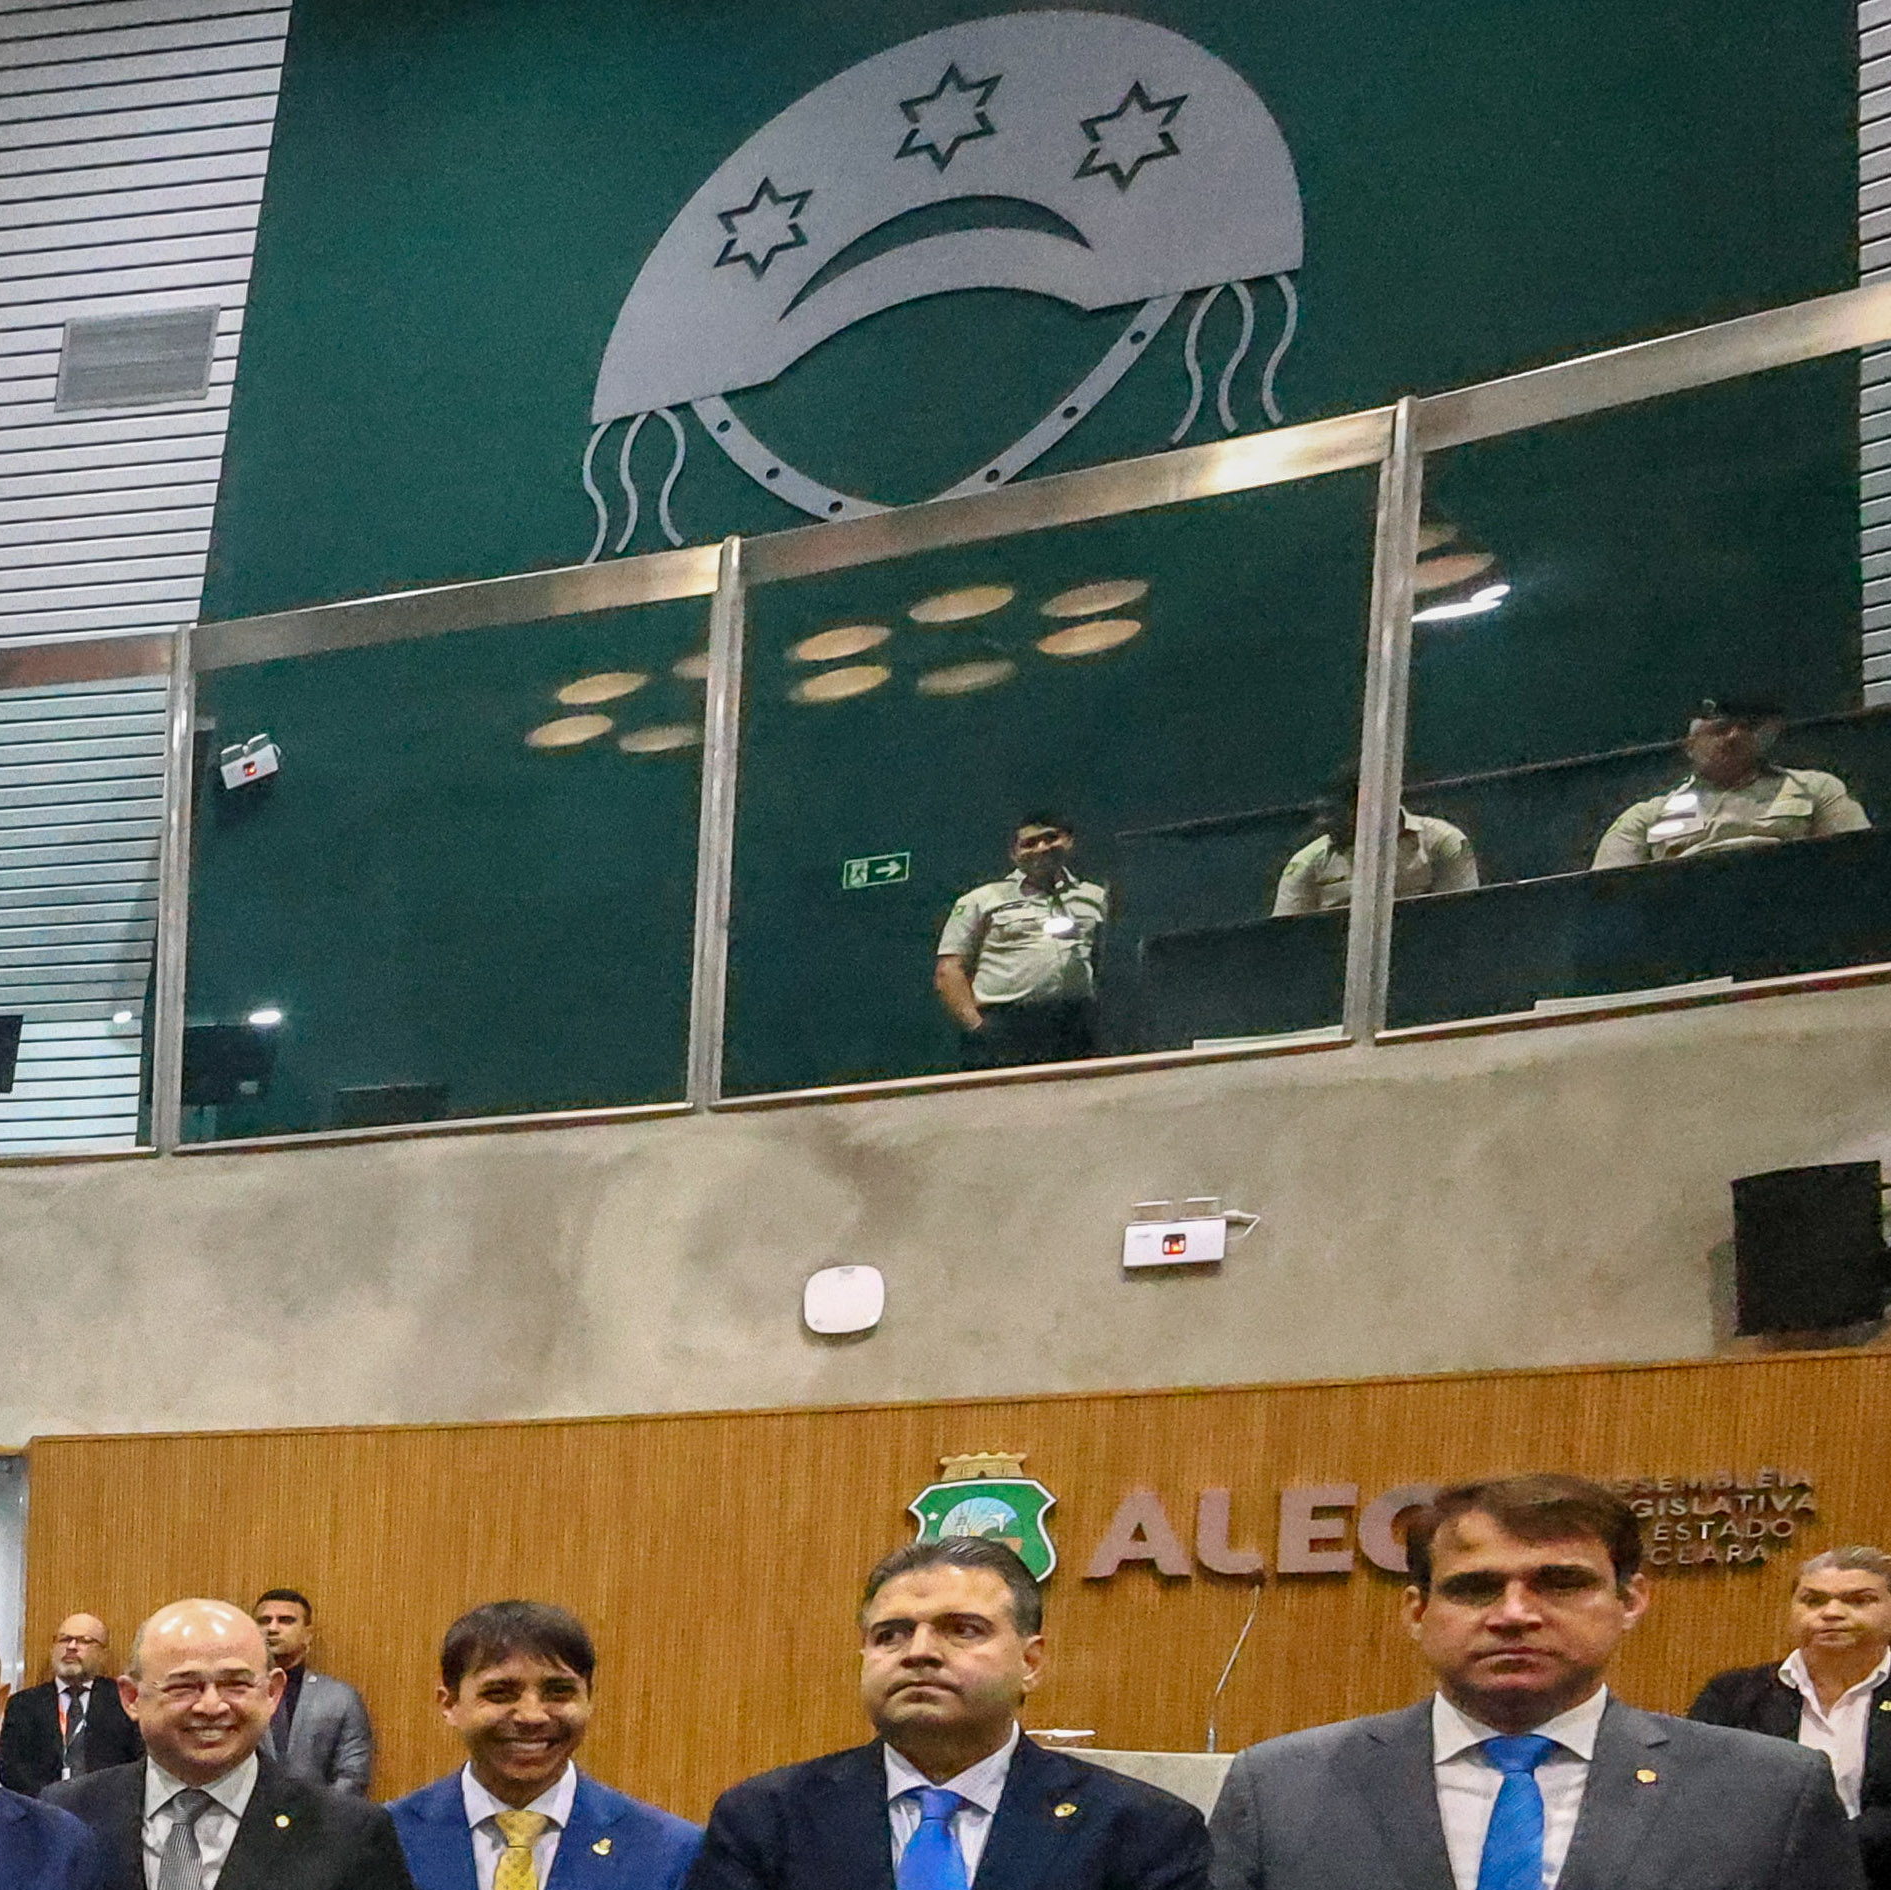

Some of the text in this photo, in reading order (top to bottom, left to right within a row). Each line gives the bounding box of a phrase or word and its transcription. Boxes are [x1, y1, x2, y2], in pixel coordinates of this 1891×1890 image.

[1630, 1493, 1816, 1518] GISLATIVA
[1082, 1481, 1439, 1578] ALEC
[1654, 1518, 1795, 1541] ESTADO
